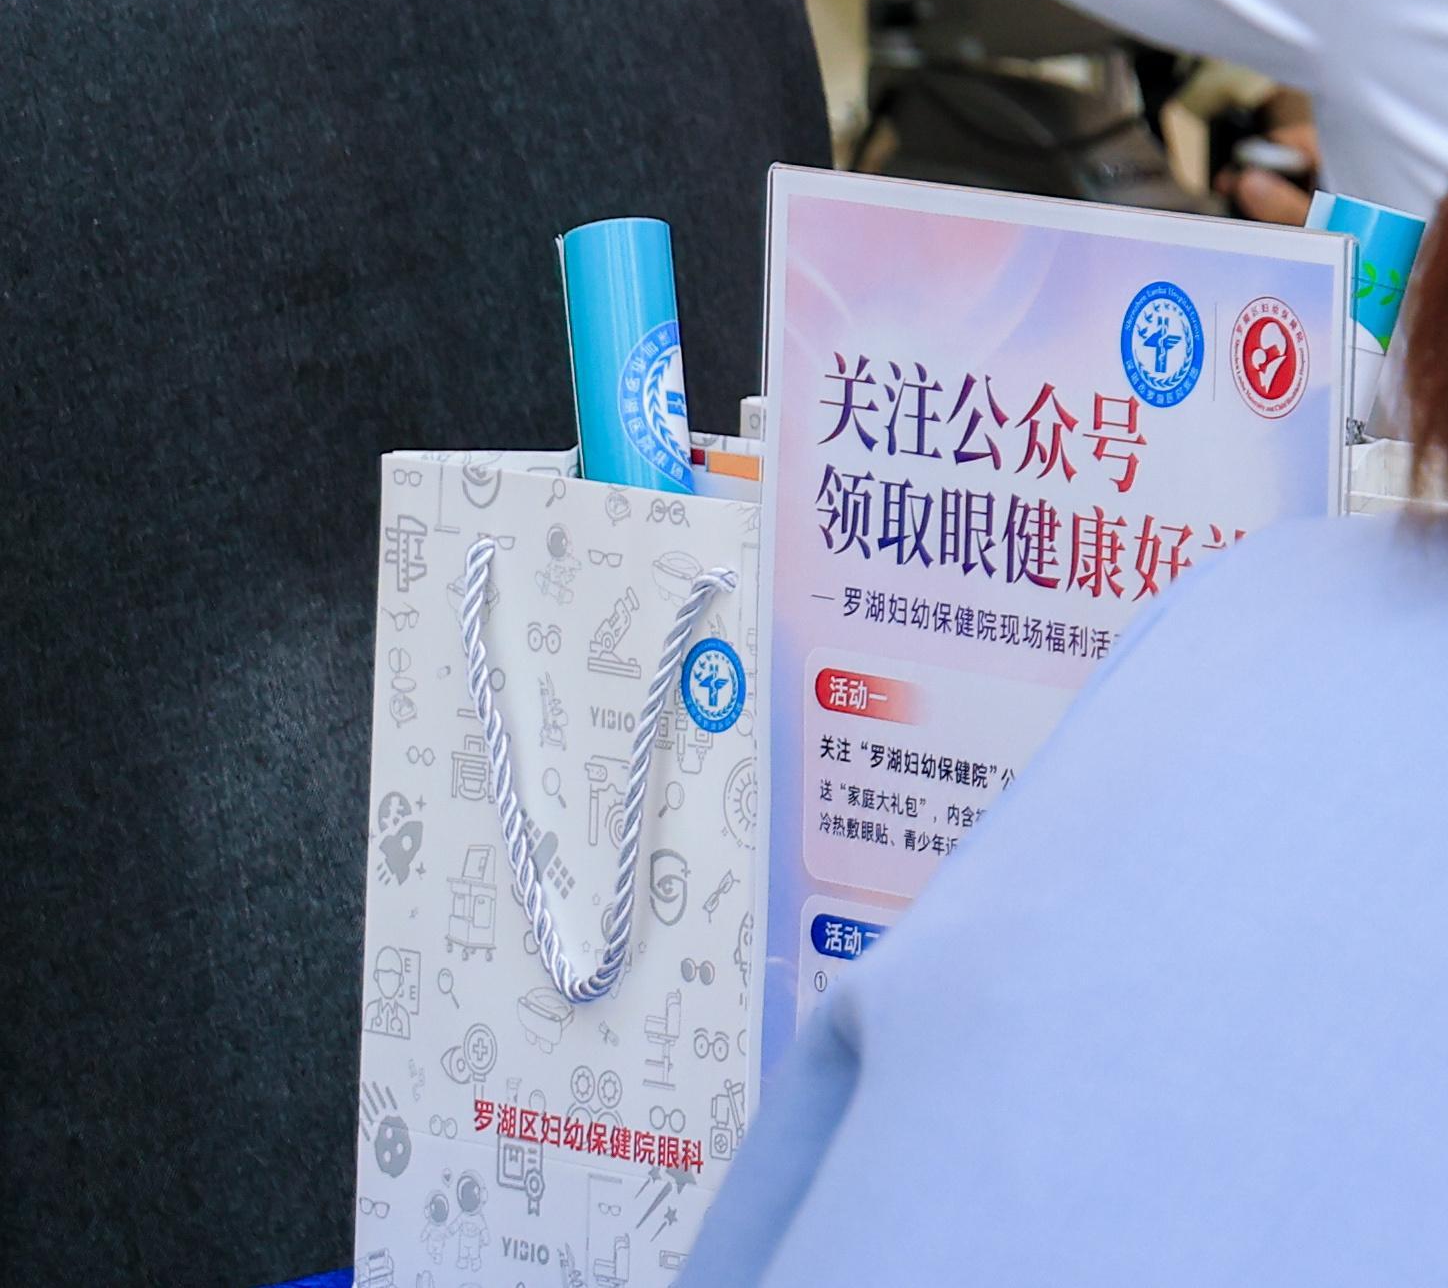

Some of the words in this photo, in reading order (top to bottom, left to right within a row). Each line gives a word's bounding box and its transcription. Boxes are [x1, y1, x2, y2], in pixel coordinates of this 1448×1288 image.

[816, 351, 1148, 493] 关注公众号
[842, 586, 1122, 661] 罗湖妇幼保健院现场福利活
[829, 675, 888, 711] 活动一
[820, 778, 988, 828] 送“家庭大礼包”，内含
[473, 1098, 704, 1175] 罗湖区妇幼保健院眼科
